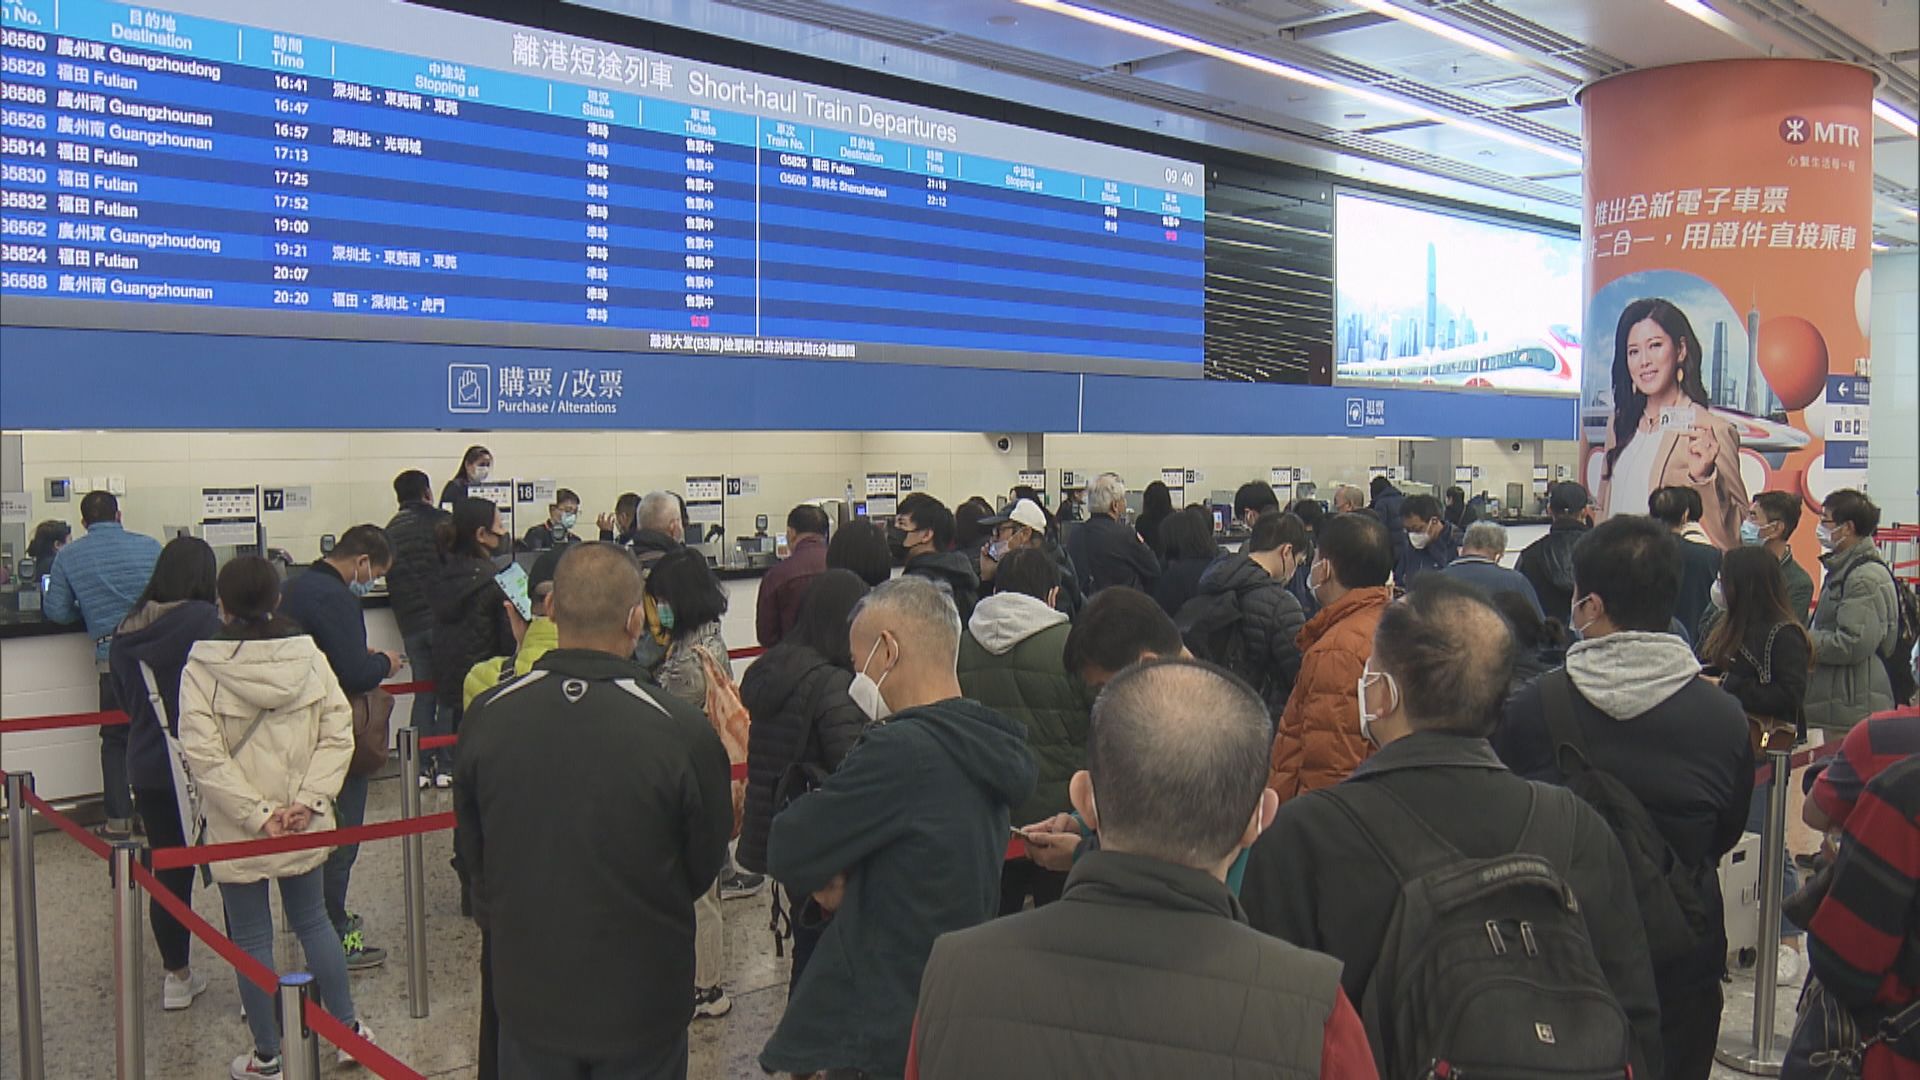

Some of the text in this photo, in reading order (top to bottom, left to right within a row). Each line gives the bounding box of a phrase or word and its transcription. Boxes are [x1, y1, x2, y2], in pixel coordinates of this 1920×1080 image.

[14, 6, 42, 25] No.
[129, 9, 176, 32] 目的地
[111, 22, 193, 51] Destination
[273, 34, 303, 54] 時間
[57, 37, 106, 62] 廣州東
[109, 46, 221, 82] Guangzhoudong
[274, 74, 308, 92] 16:41
[272, 50, 305, 69] Time
[57, 63, 89, 84] 福田
[94, 70, 138, 91] Futian
[274, 98, 309, 116] 16:47
[415, 73, 480, 98] Stopping at
[512, 31, 958, 144] 離港短途列車 Short-haul Train Departures
[57, 89, 106, 114] 廣州南
[109, 98, 213, 128] Guangzhounan
[274, 122, 309, 140] 16:57
[582, 102, 615, 119] Status
[684, 119, 717, 136] Tickets
[1814, 121, 1860, 148] MTR
[57, 115, 106, 139] 廣州南
[109, 123, 213, 151] Guangzhounan
[274, 146, 309, 163] 17:13
[766, 134, 805, 150] Train No.
[840, 145, 884, 163] Destination
[57, 142, 89, 163] 福田
[94, 148, 138, 168] Futian
[274, 170, 309, 188] 17:25
[831, 162, 855, 176] Futian
[926, 161, 944, 174] Time
[1165, 167, 1194, 187] 09 40
[57, 168, 89, 189] 福田
[94, 174, 138, 194] Futian
[274, 194, 309, 211] 17:52
[839, 180, 887, 198] Shenzhenbei
[57, 194, 89, 216] 福田
[94, 200, 138, 219] Futian
[274, 217, 309, 234] 19:00
[1594, 185, 1790, 228] 推出全新電子車票
[58, 221, 106, 242] 廣州東
[110, 227, 221, 254] Guangzhoudong
[274, 242, 307, 258] 19:21
[58, 247, 90, 267] 福田
[95, 252, 139, 270] Futian
[273, 265, 309, 281] 20:07
[58, 274, 106, 294] 廣州南
[110, 279, 213, 300] Guangzhounan
[273, 290, 309, 305] 20:20
[497, 399, 549, 414] Purchase
[557, 401, 617, 414] Alterations
[727, 480, 740, 494] 19
[901, 478, 911, 488] 20
[1063, 473, 1073, 484] 21
[265, 493, 281, 508] 17
[518, 485, 533, 500] 18
